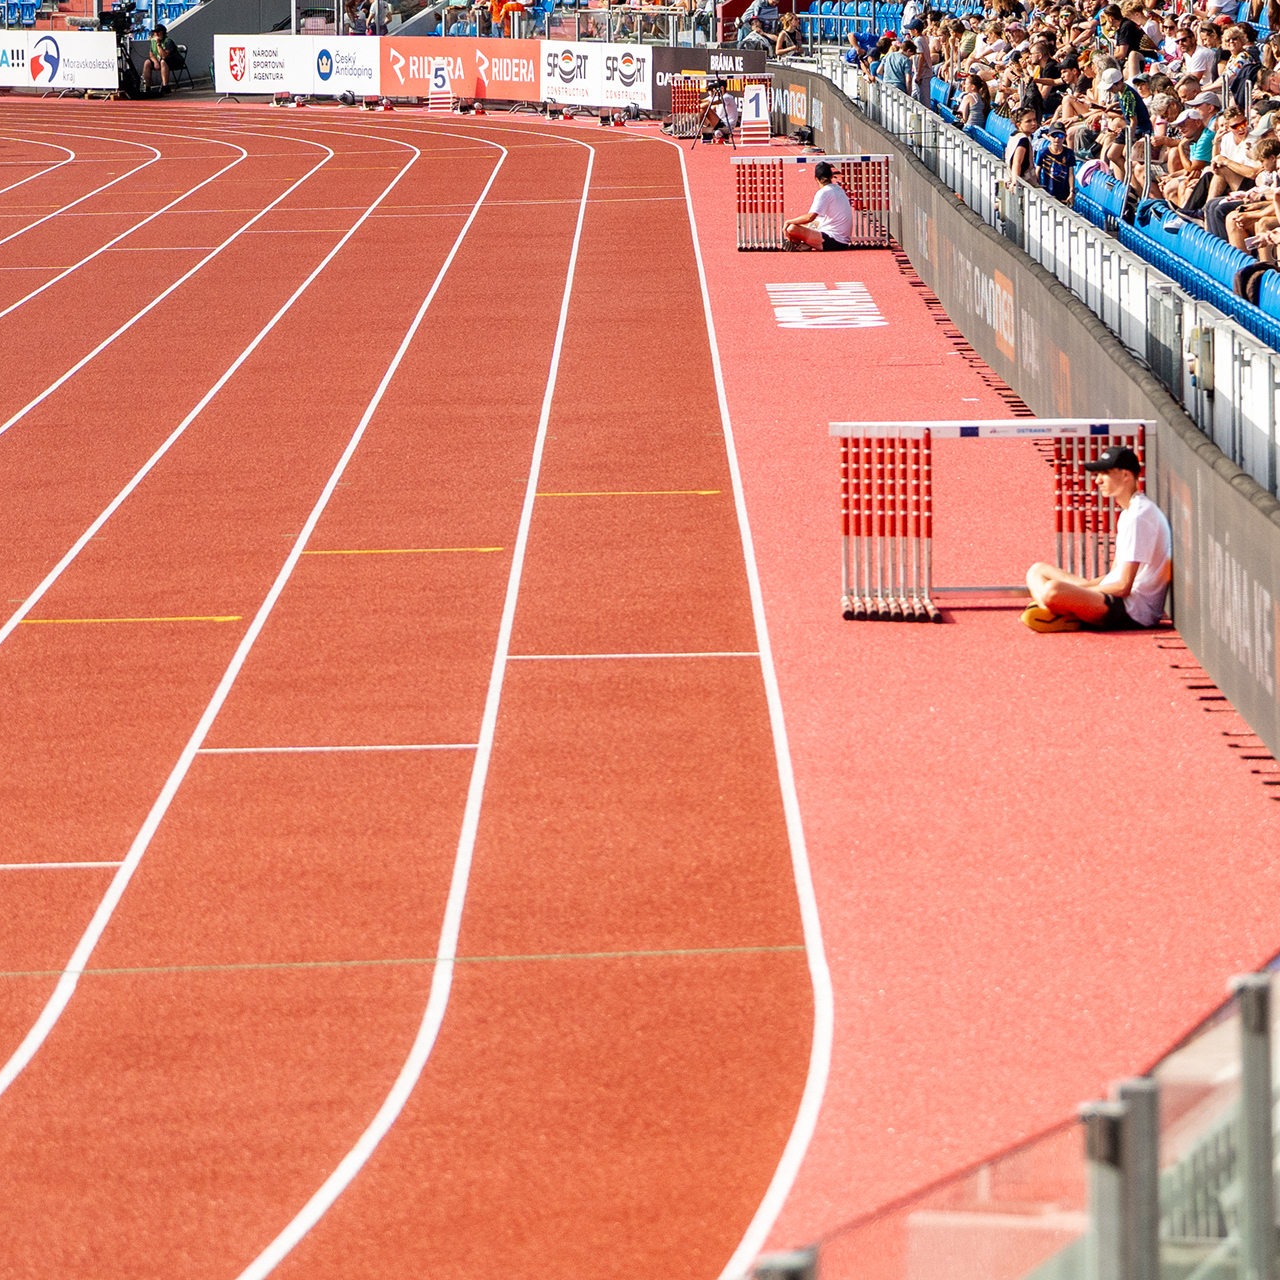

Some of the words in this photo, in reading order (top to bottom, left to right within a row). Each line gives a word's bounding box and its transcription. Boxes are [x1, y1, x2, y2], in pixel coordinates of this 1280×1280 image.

[252, 47, 279, 58] NÁRODNÍ
[334, 49, 357, 67] Český
[62, 58, 115, 72] Moravskoslezský
[252, 59, 286, 70] SPORTOVNÍ
[710, 53, 734, 71] BRÁNA
[735, 56, 744, 71] KE
[62, 71, 76, 82] kraj
[253, 72, 284, 81] AGENTURA
[334, 64, 373, 80] Antidoping
[492, 57, 535, 82] RIDERA
[433, 67, 447, 89] 5
[546, 86, 589, 98] CONSTRUCTION
[605, 90, 647, 101] CONSTRUCTION
[749, 92, 761, 118] 1
